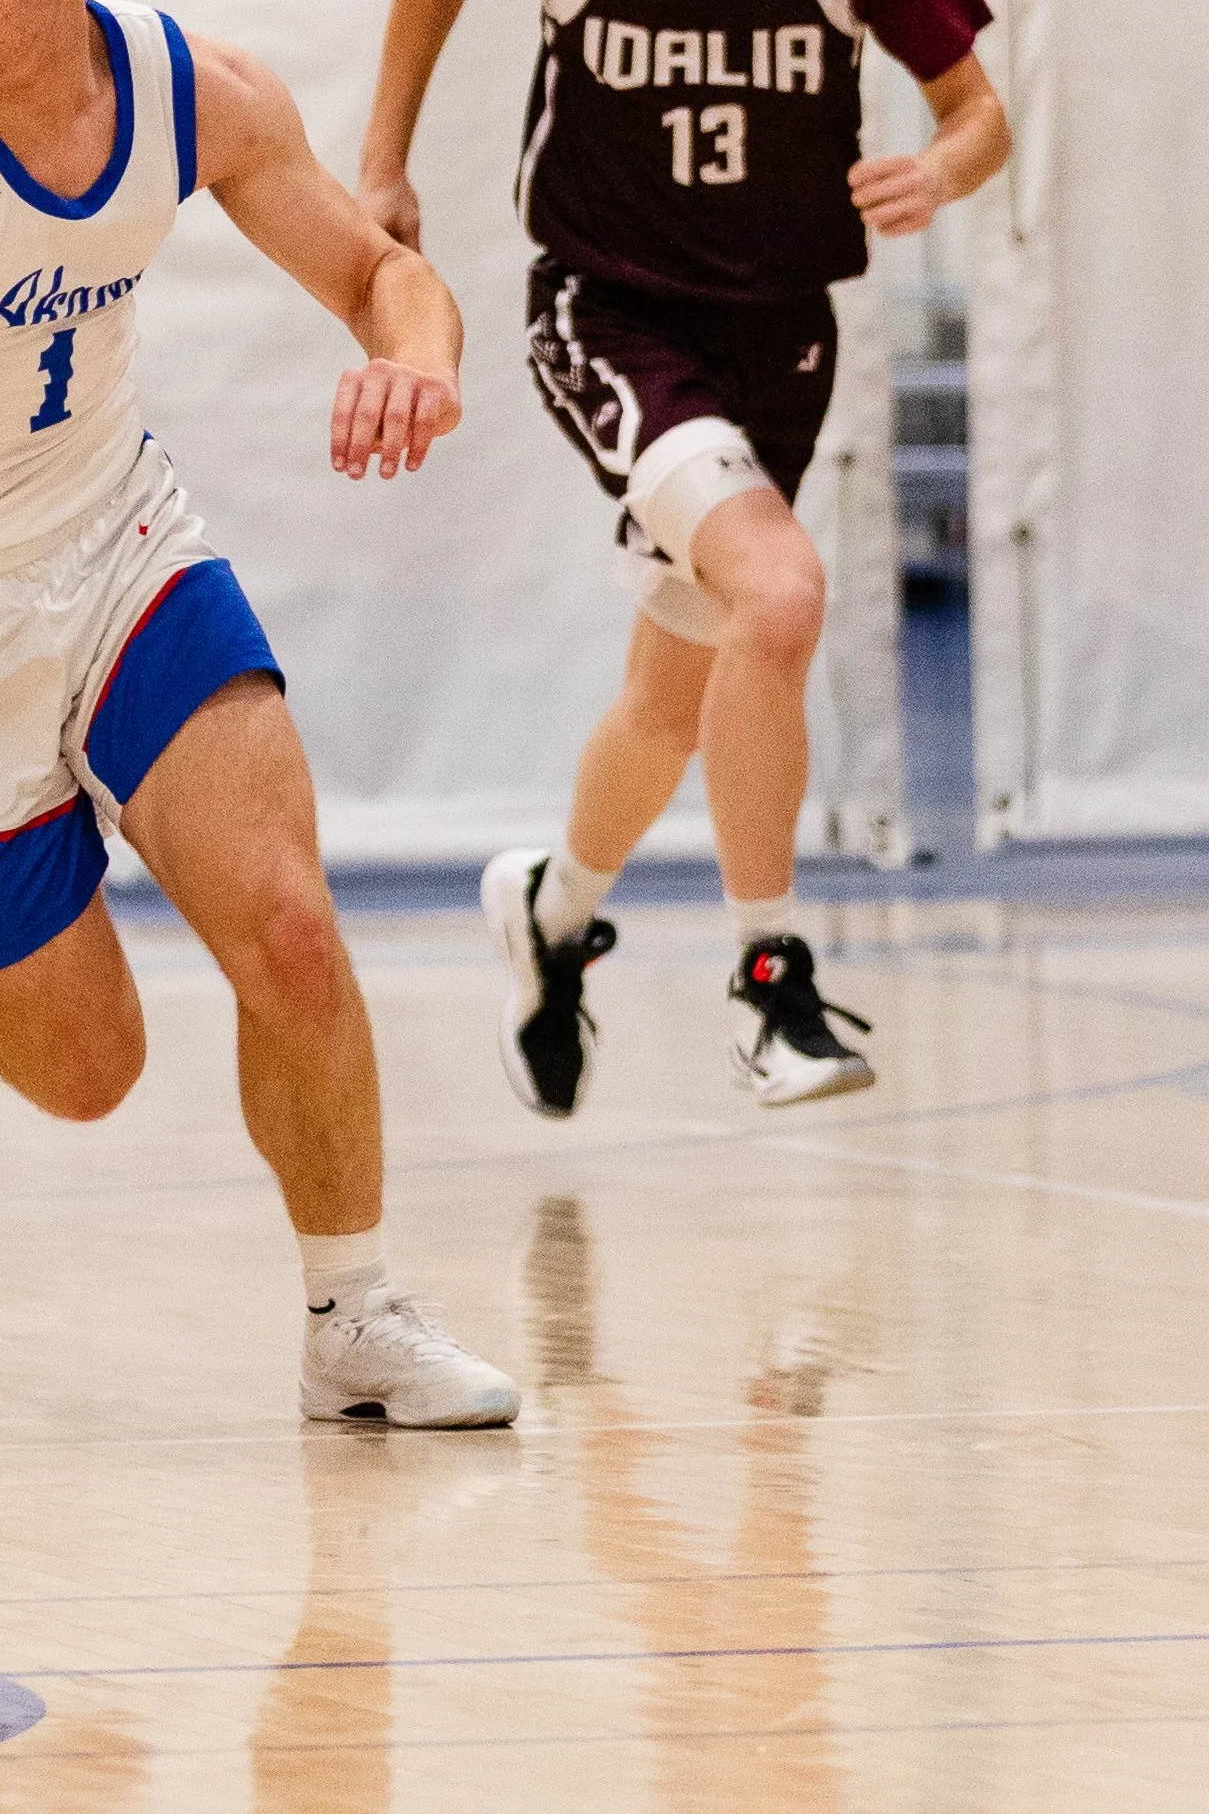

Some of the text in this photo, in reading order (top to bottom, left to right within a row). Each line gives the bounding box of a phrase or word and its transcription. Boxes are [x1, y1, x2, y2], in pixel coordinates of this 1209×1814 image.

[584, 16, 825, 95] IDALIA
[660, 103, 748, 186] 13
[29, 327, 77, 434] 1
